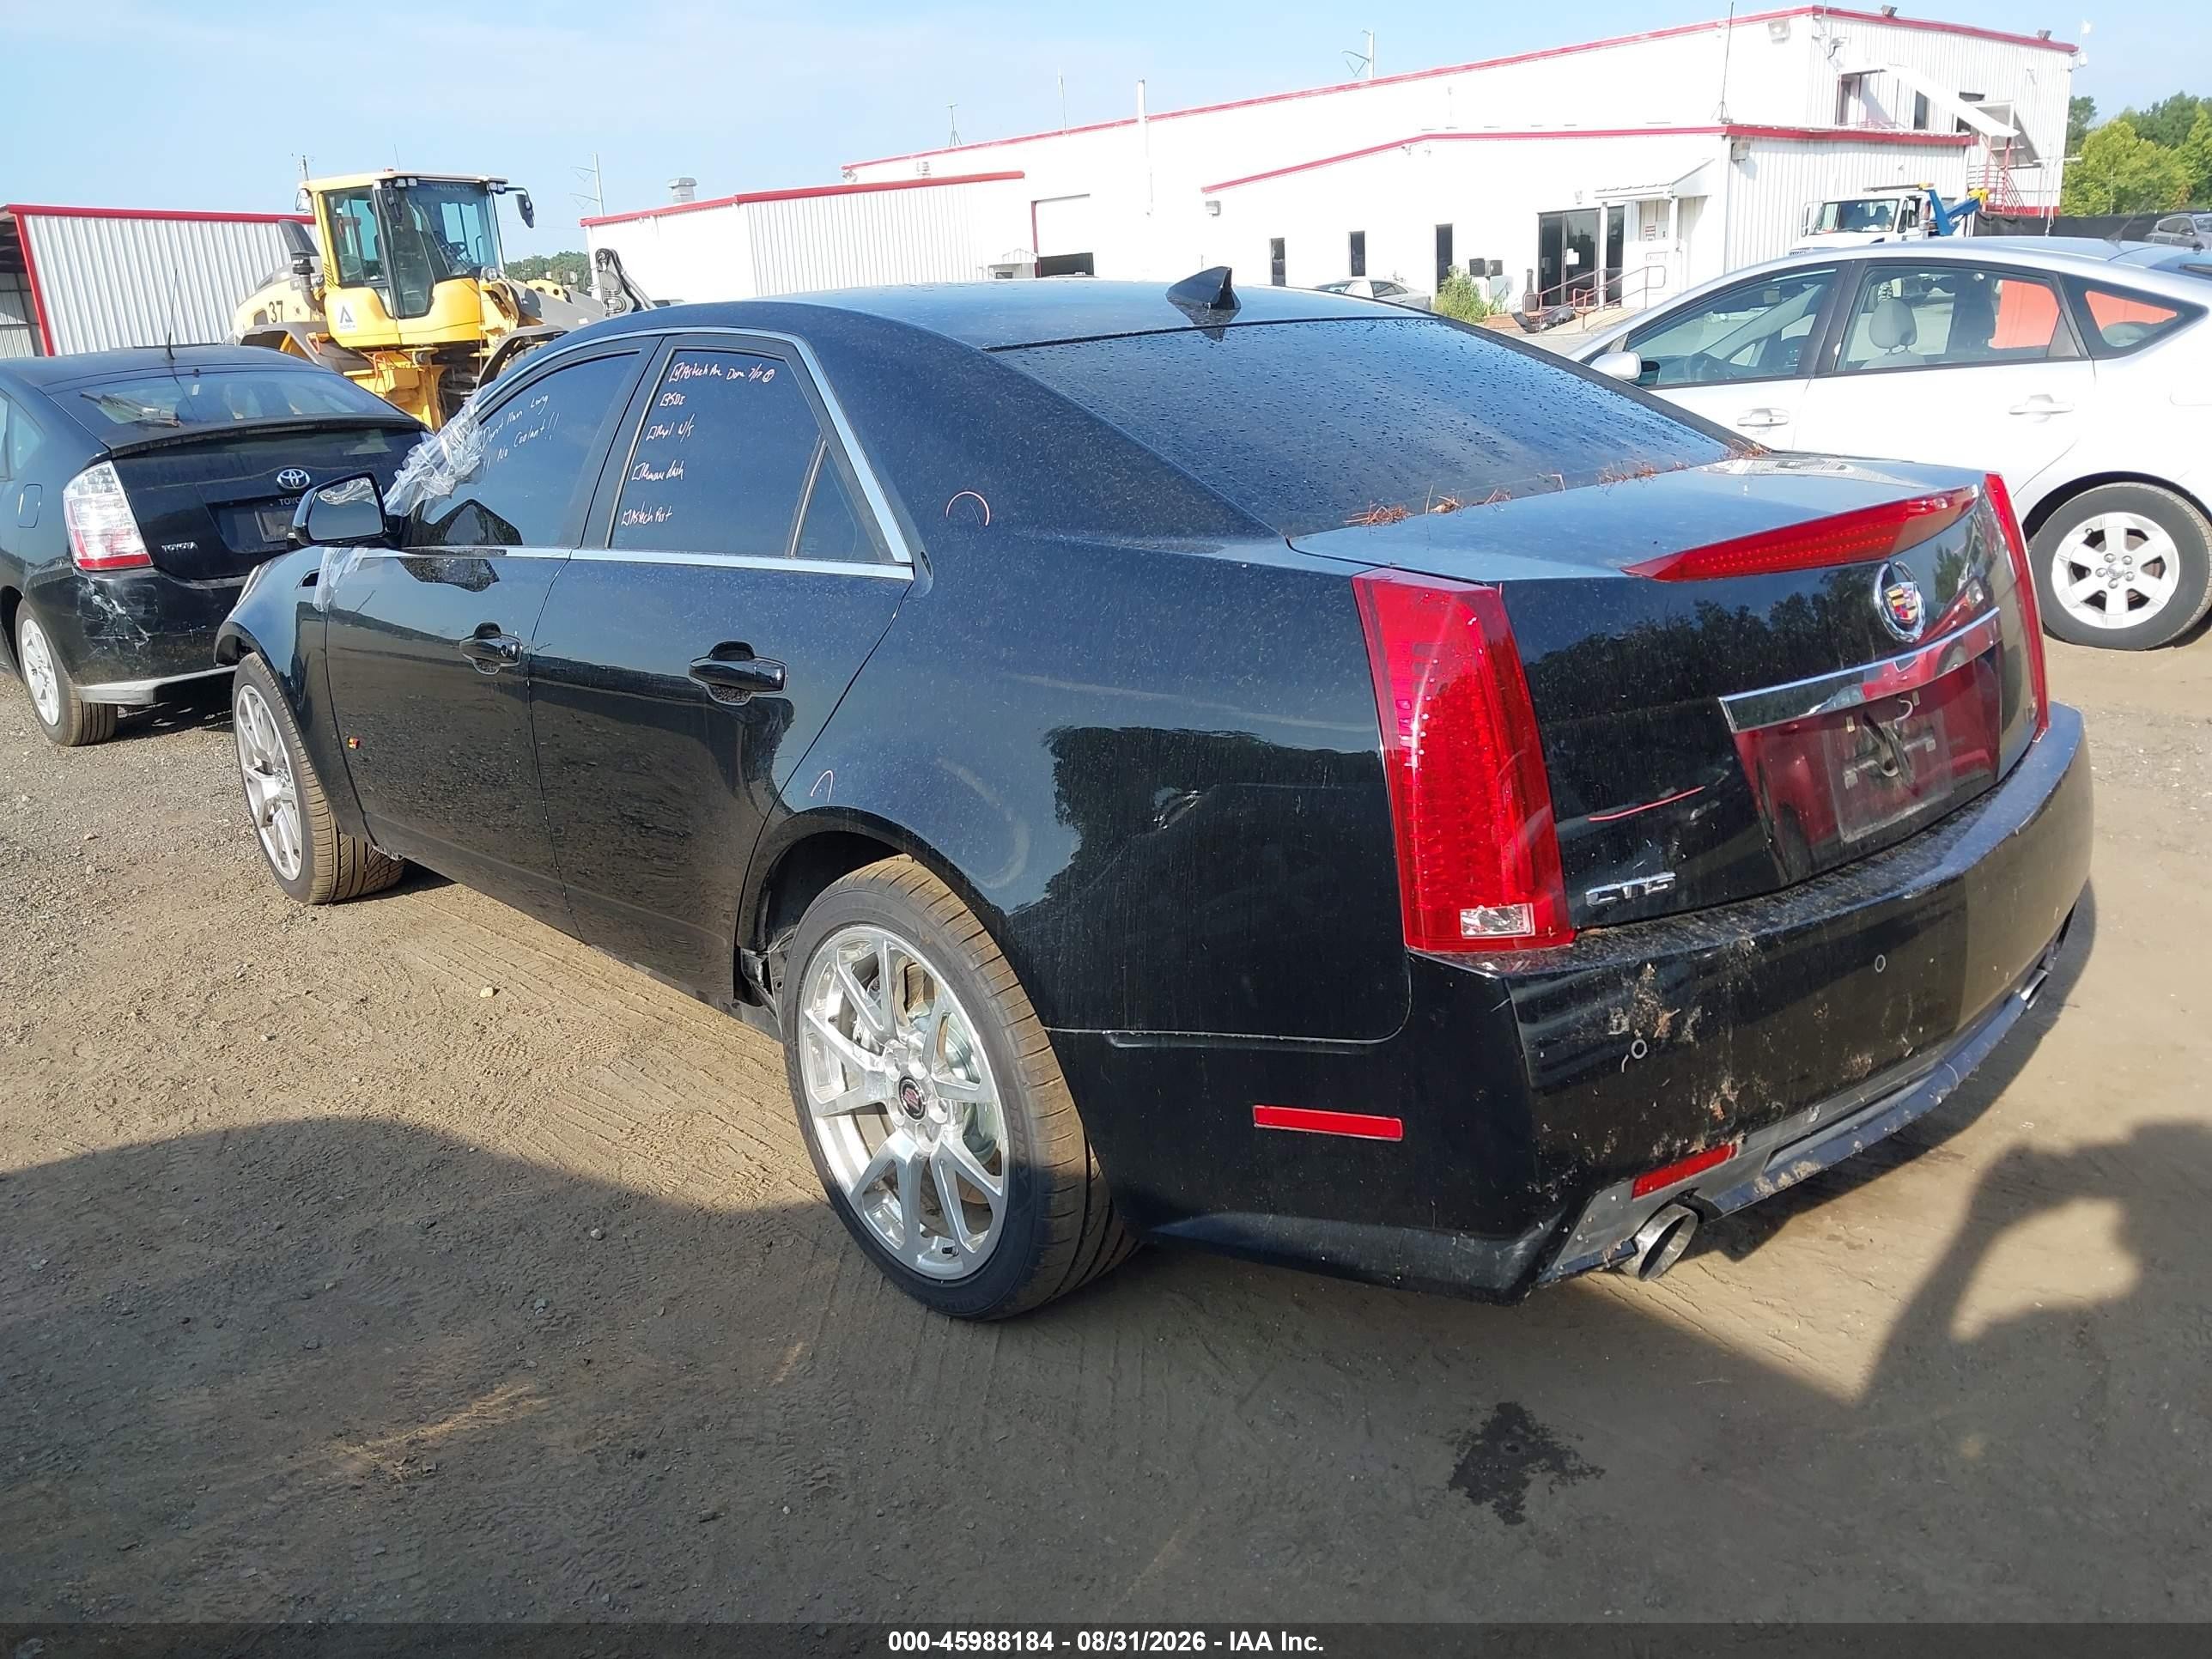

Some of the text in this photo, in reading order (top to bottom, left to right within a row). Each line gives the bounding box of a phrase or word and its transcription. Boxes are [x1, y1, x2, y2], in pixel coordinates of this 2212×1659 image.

[431, 183, 470, 193] VOLVO
[269, 301, 283, 323] 37
[497, 446, 508, 462] No
[278, 496, 302, 507] TOYO
[161, 541, 198, 553] TOYOTA
